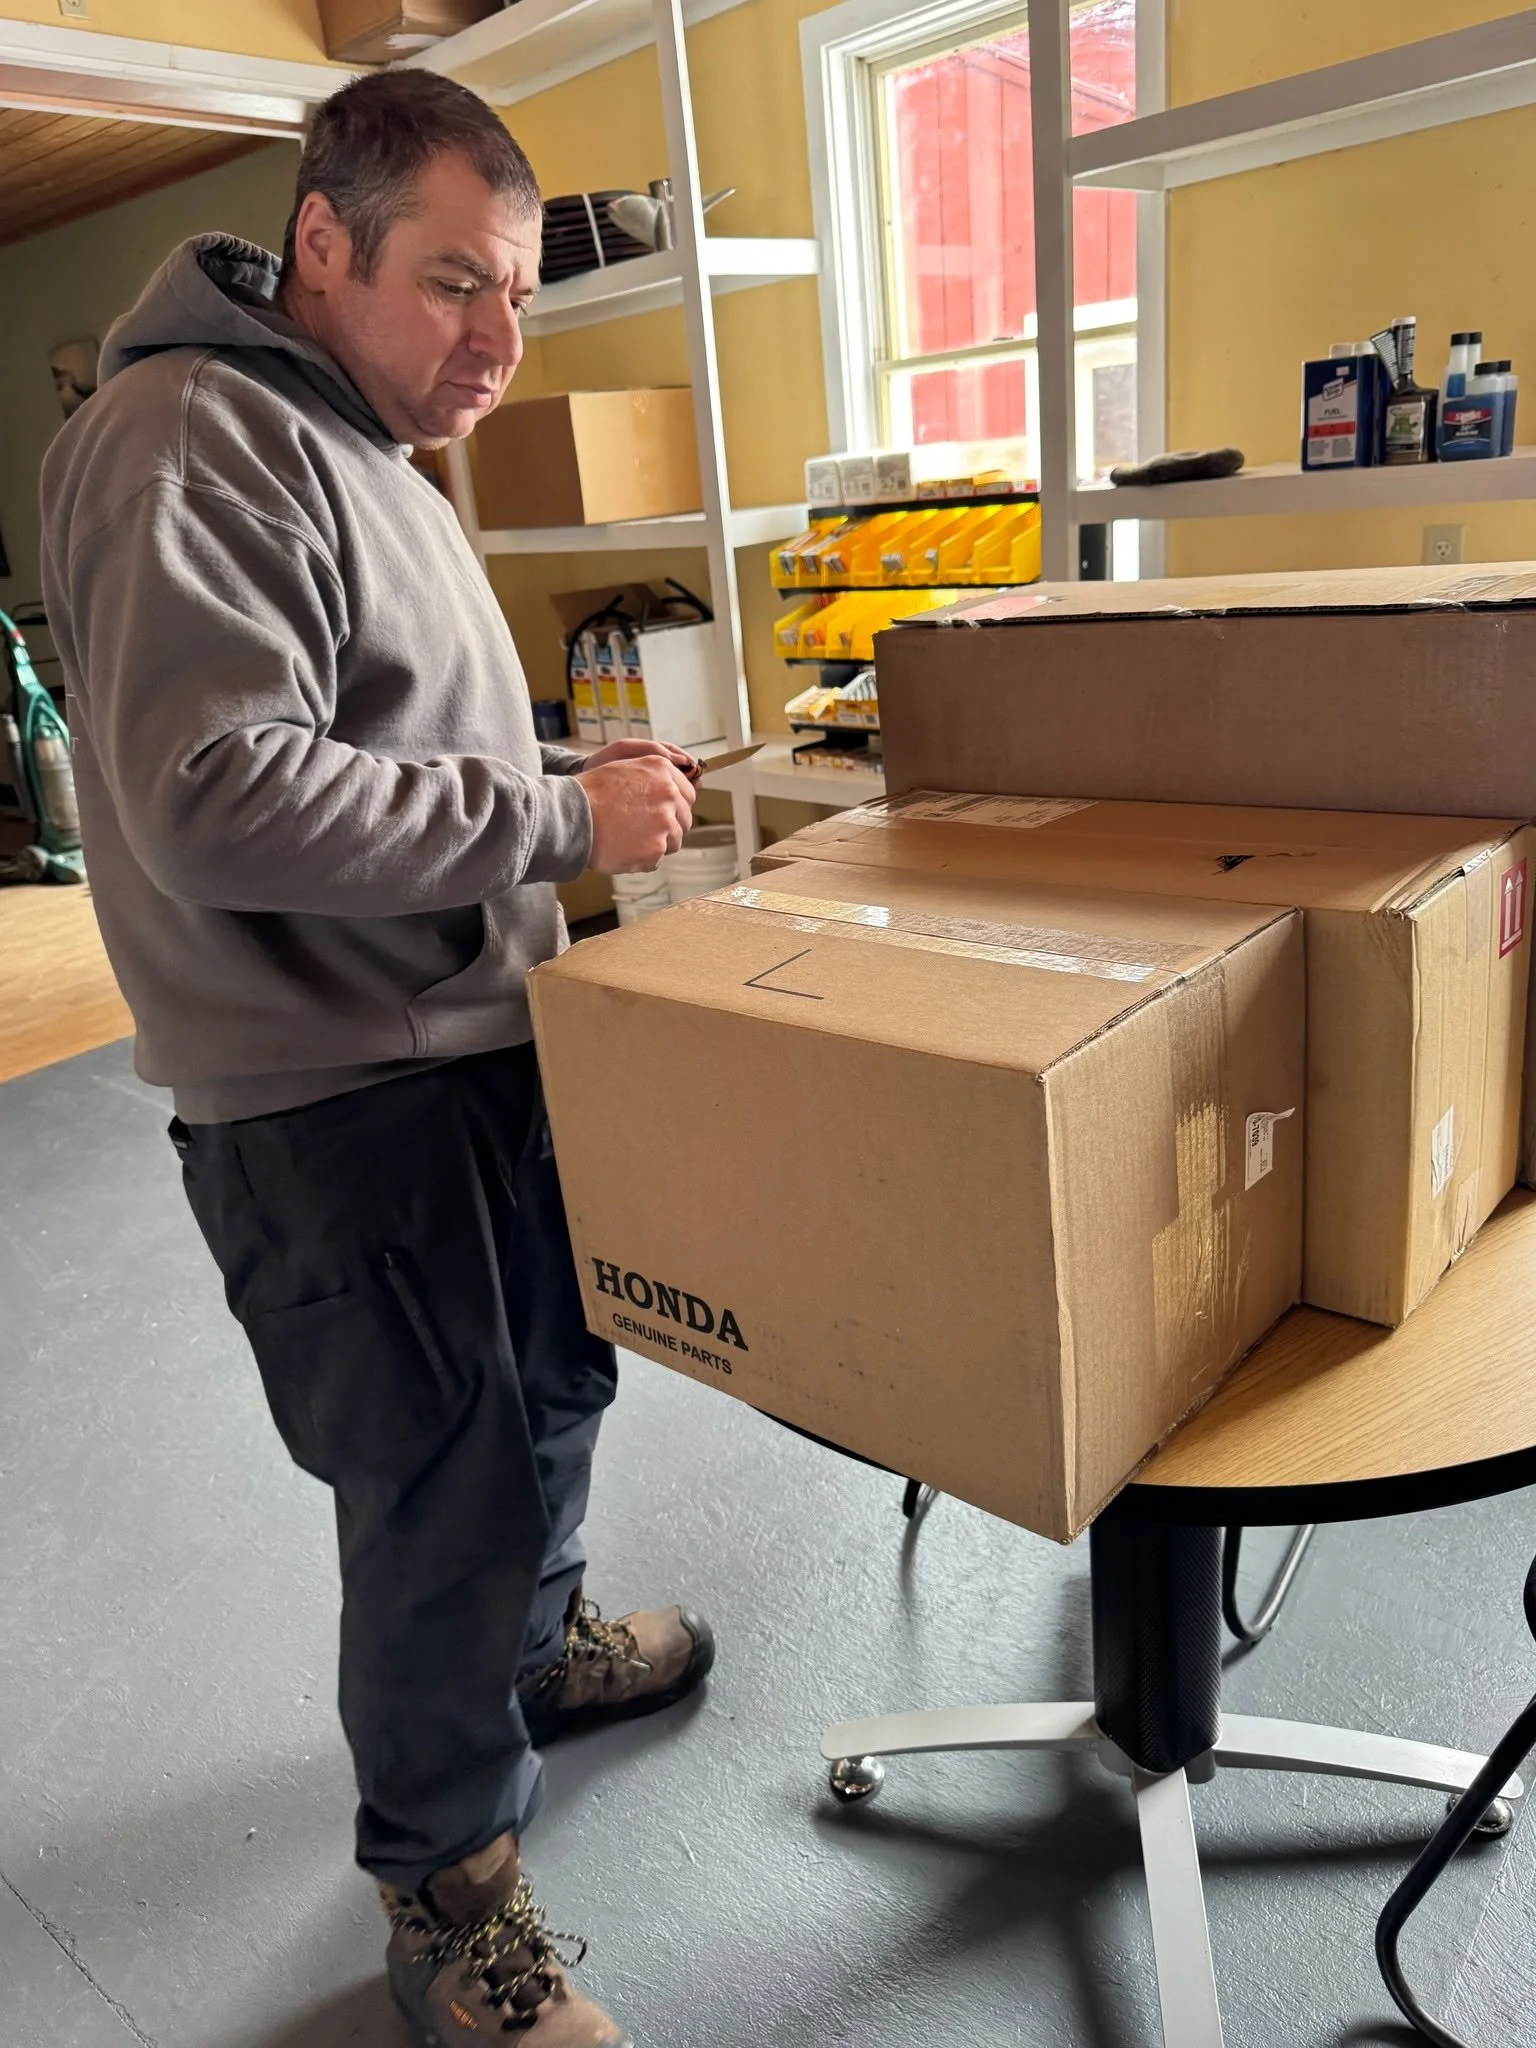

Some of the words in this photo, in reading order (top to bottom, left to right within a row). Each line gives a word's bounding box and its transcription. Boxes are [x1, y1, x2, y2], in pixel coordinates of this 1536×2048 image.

[592, 1257, 749, 1352] HONDA
[612, 1312, 678, 1352] GENUINE
[681, 1340, 733, 1375] PARTS
